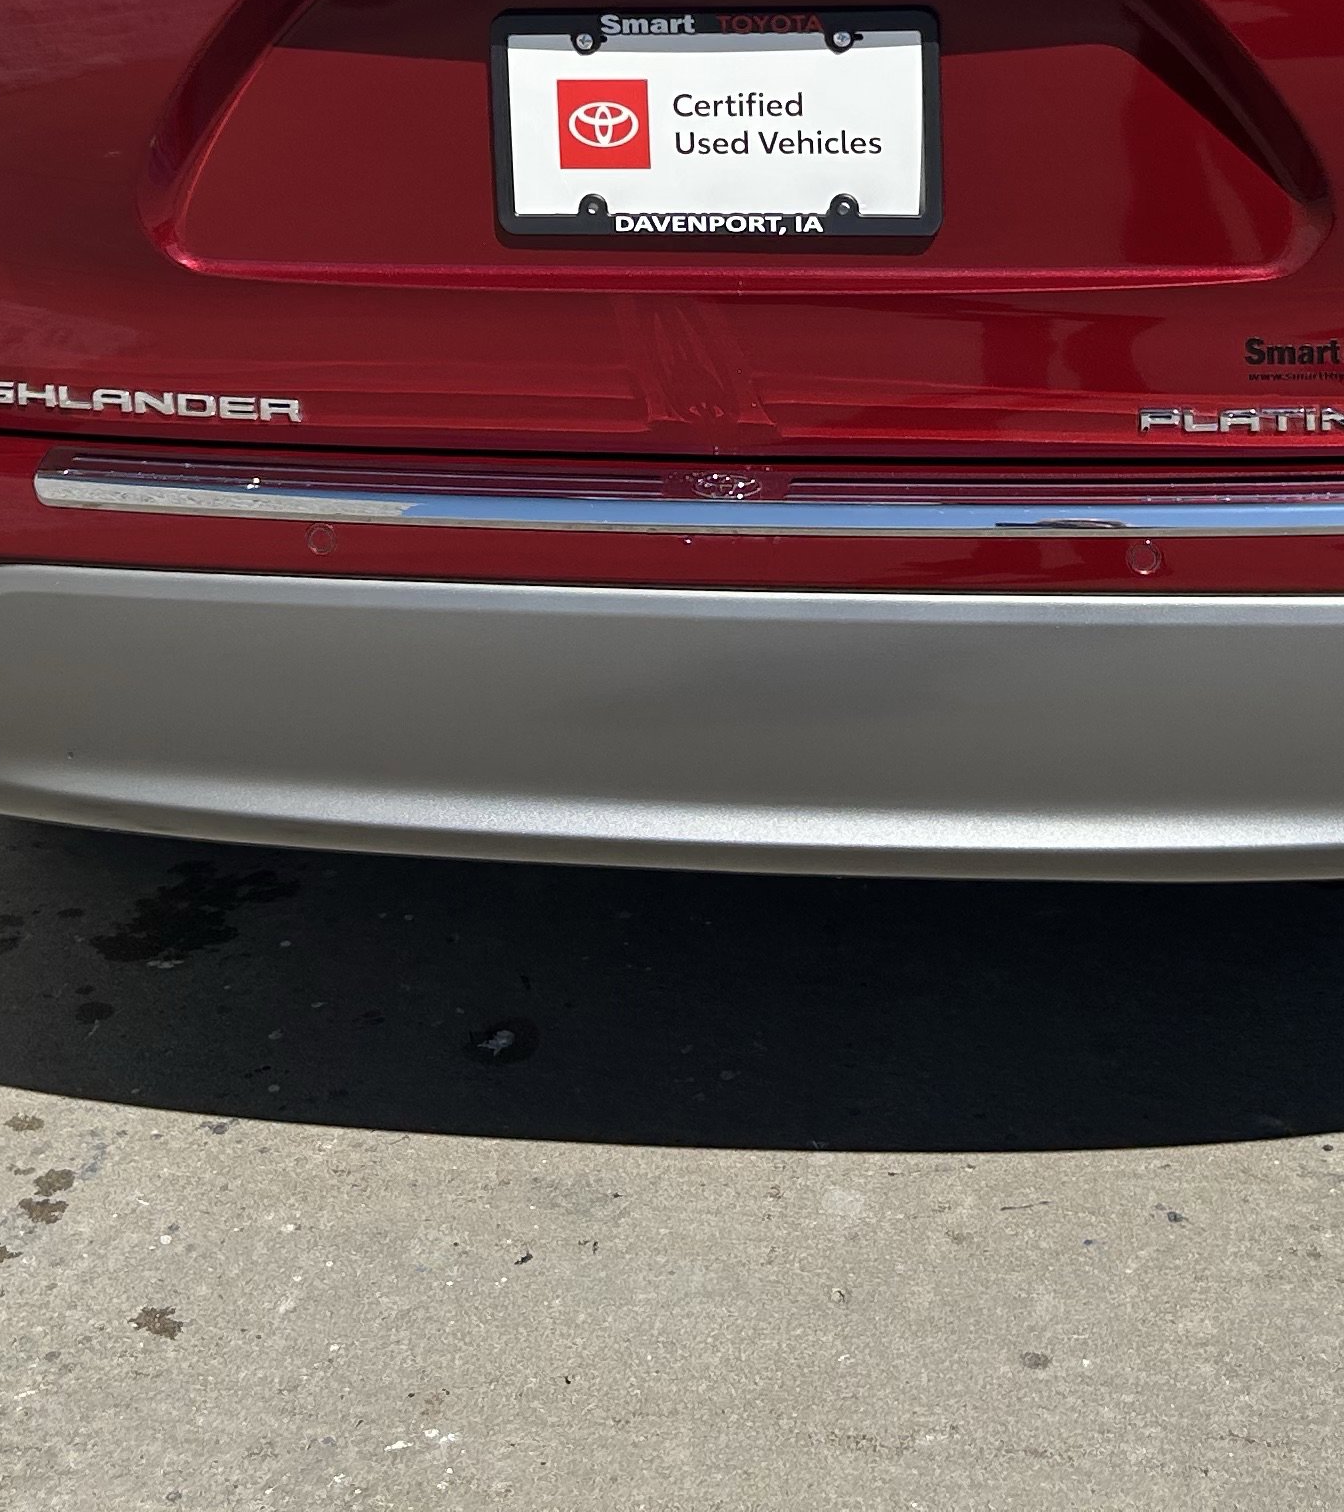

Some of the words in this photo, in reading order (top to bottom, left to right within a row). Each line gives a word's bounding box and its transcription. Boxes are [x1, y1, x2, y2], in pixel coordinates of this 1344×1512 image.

[600, 14, 696, 35] Smart
[716, 14, 825, 34] TOYOTA
[672, 92, 804, 118] Certified
[674, 131, 749, 156] Used
[758, 130, 883, 155] Vehicles
[614, 215, 788, 236] DAVENPORT,
[795, 214, 824, 234] IA
[1244, 338, 1340, 365] Smart
